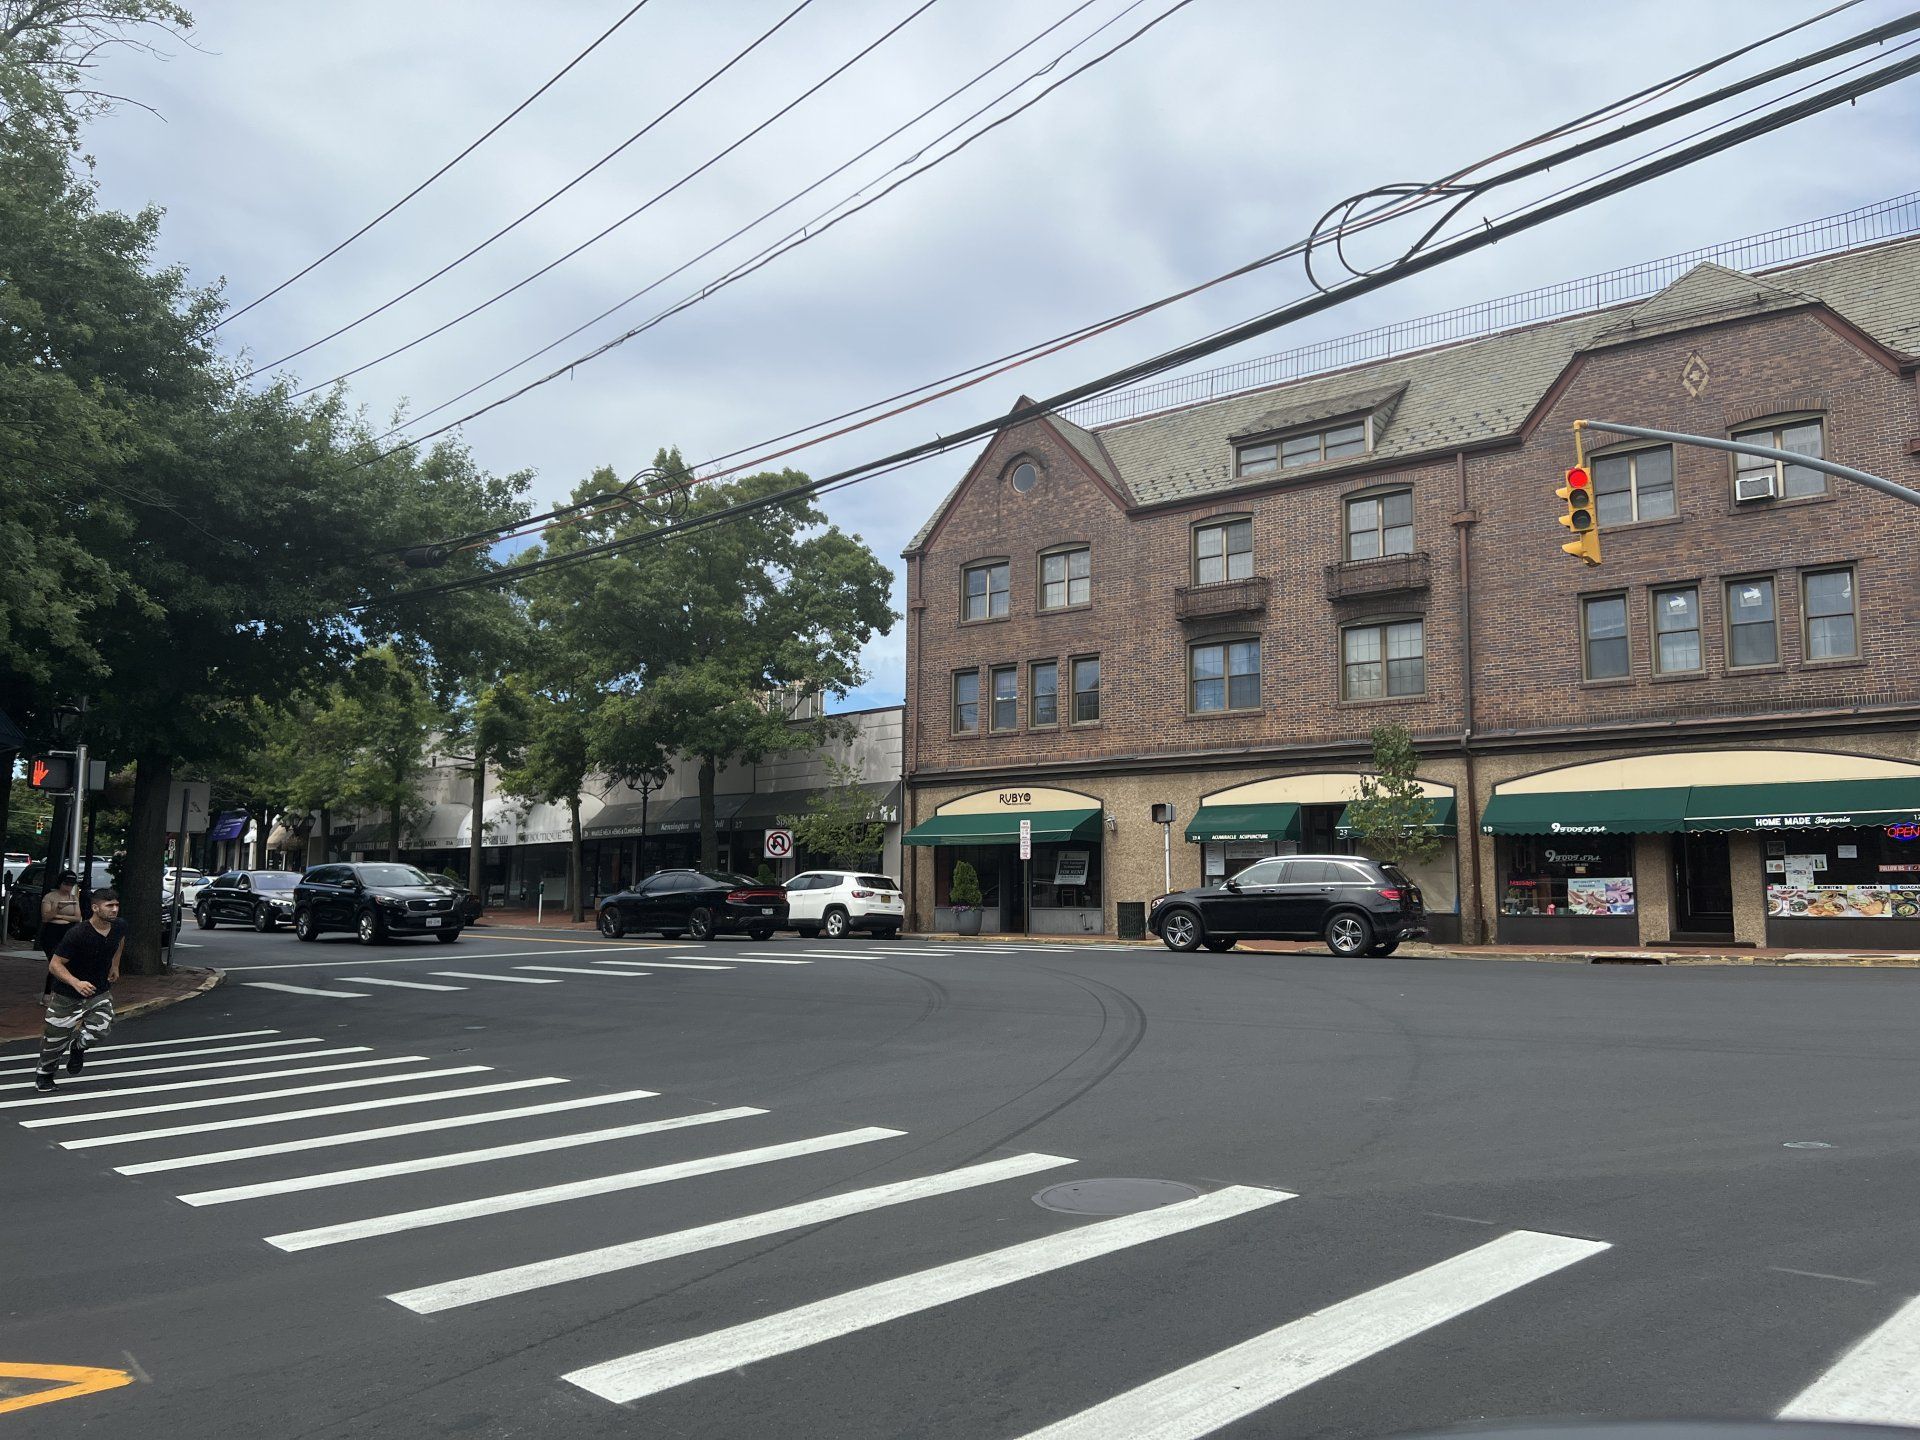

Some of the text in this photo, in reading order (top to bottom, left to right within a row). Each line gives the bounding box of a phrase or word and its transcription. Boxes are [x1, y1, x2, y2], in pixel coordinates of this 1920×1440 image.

[1755, 816, 1851, 827] HOME MADE Taqueria
[1888, 827, 1920, 837] OPEN
